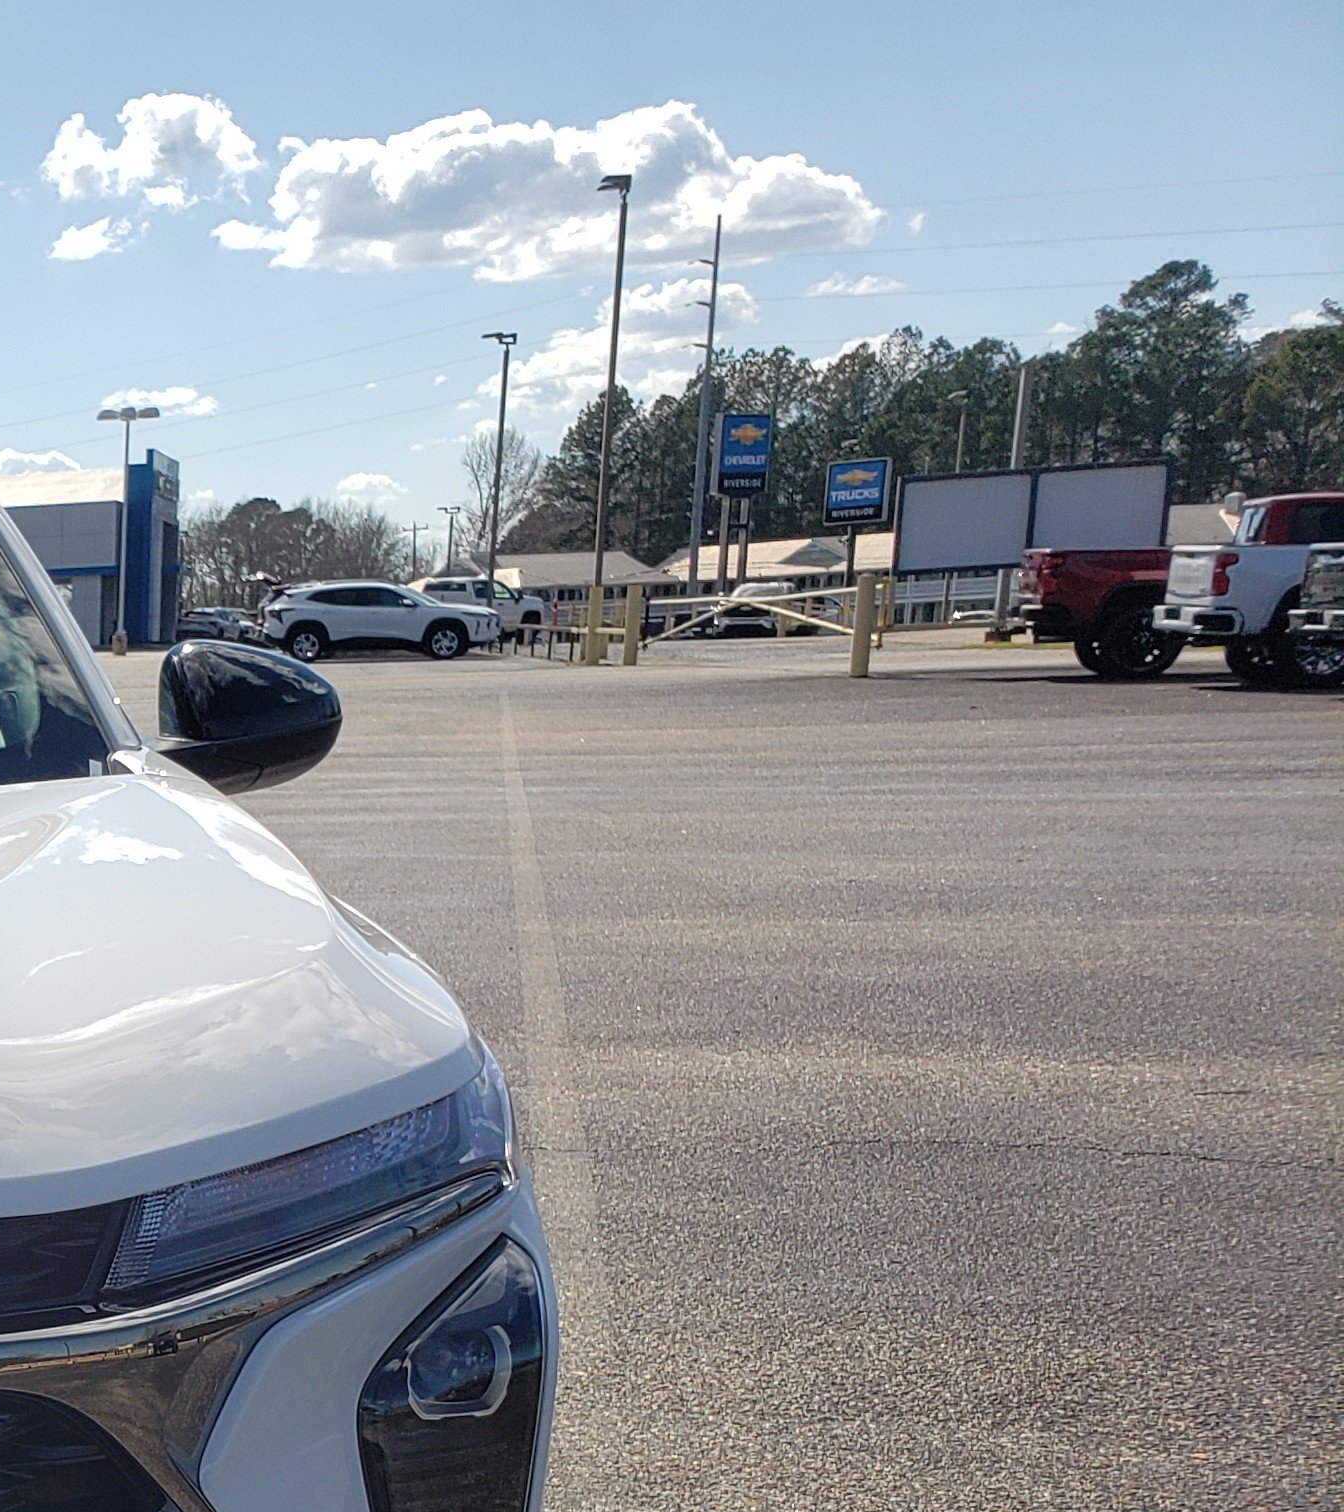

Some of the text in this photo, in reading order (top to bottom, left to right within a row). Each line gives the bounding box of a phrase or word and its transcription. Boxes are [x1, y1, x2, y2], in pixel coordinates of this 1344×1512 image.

[723, 478, 762, 489] RIVERSIDE
[831, 487, 879, 502] TRUCKS
[832, 507, 874, 518] RIVERSIDE
